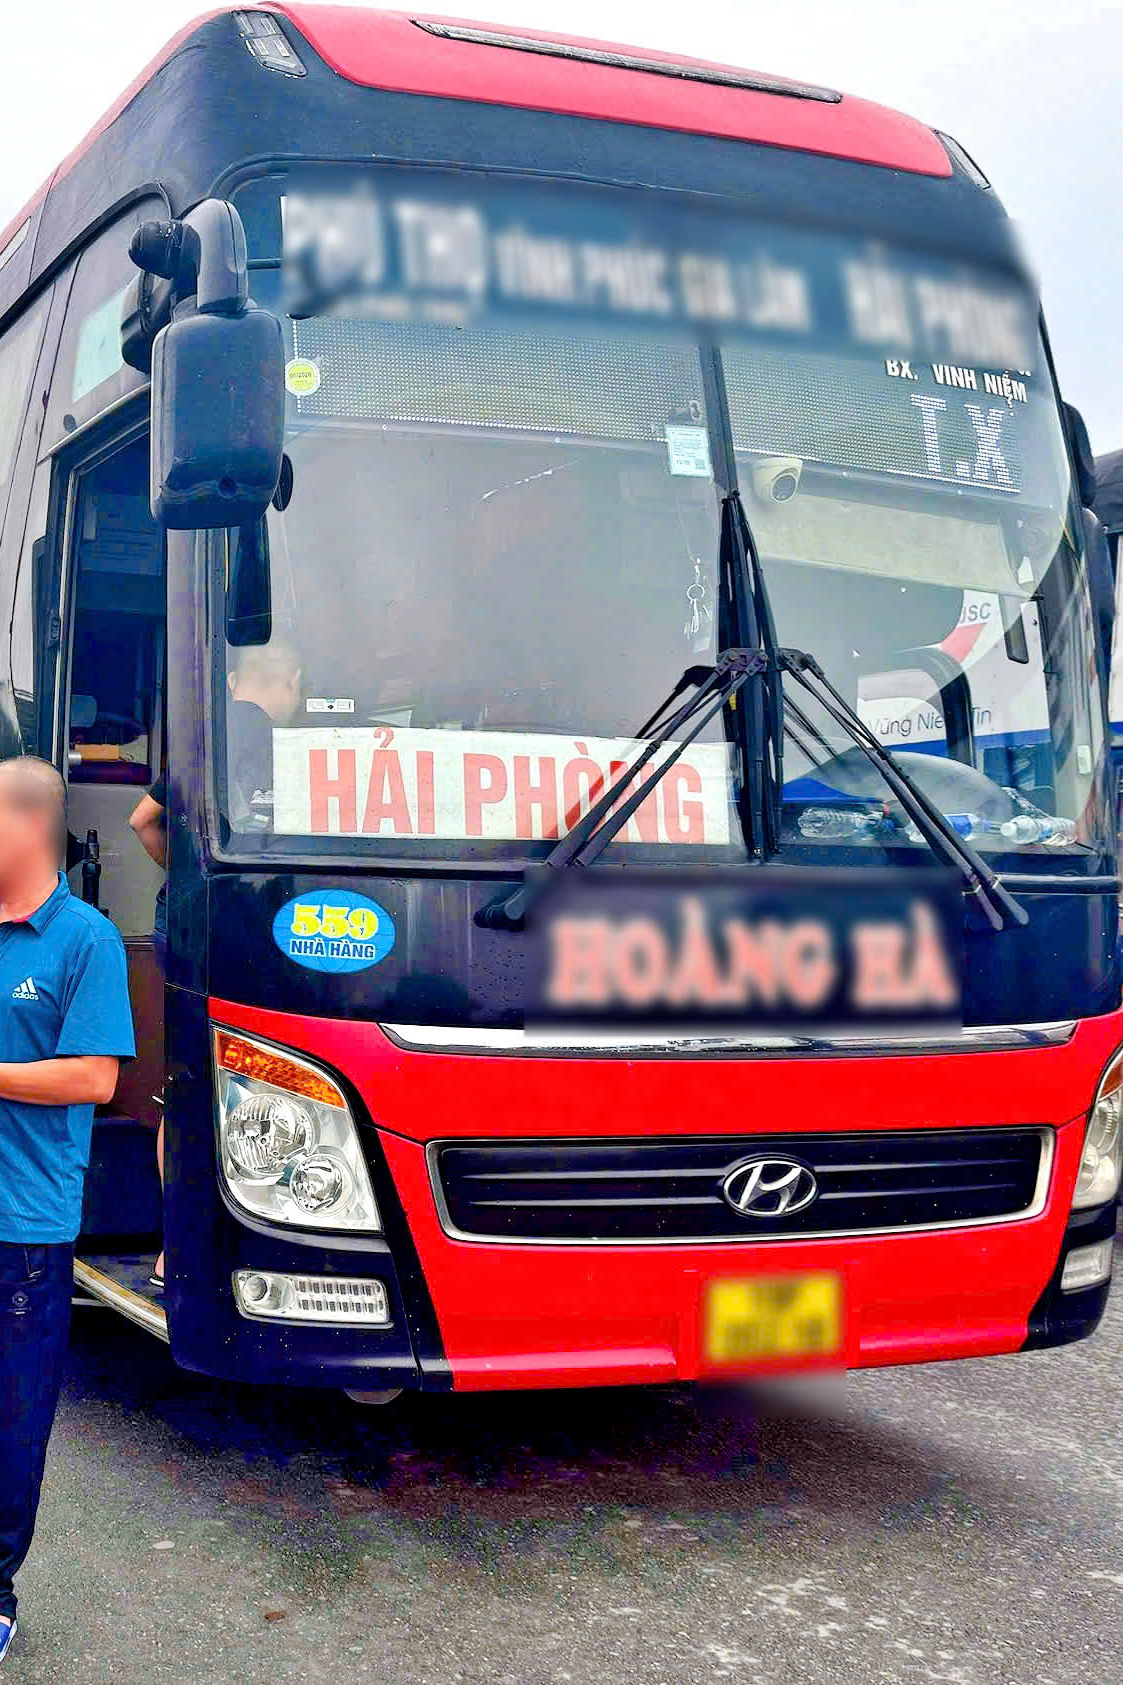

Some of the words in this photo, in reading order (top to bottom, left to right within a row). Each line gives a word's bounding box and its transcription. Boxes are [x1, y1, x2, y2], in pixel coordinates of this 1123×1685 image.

[308, 726, 436, 835] HẢI
[463, 742, 705, 844] PHÒNG
[291, 903, 379, 940] 559
[291, 937, 325, 956] NHÀ
[329, 939, 375, 958] HÀNG
[12, 992, 39, 1001] adidas
